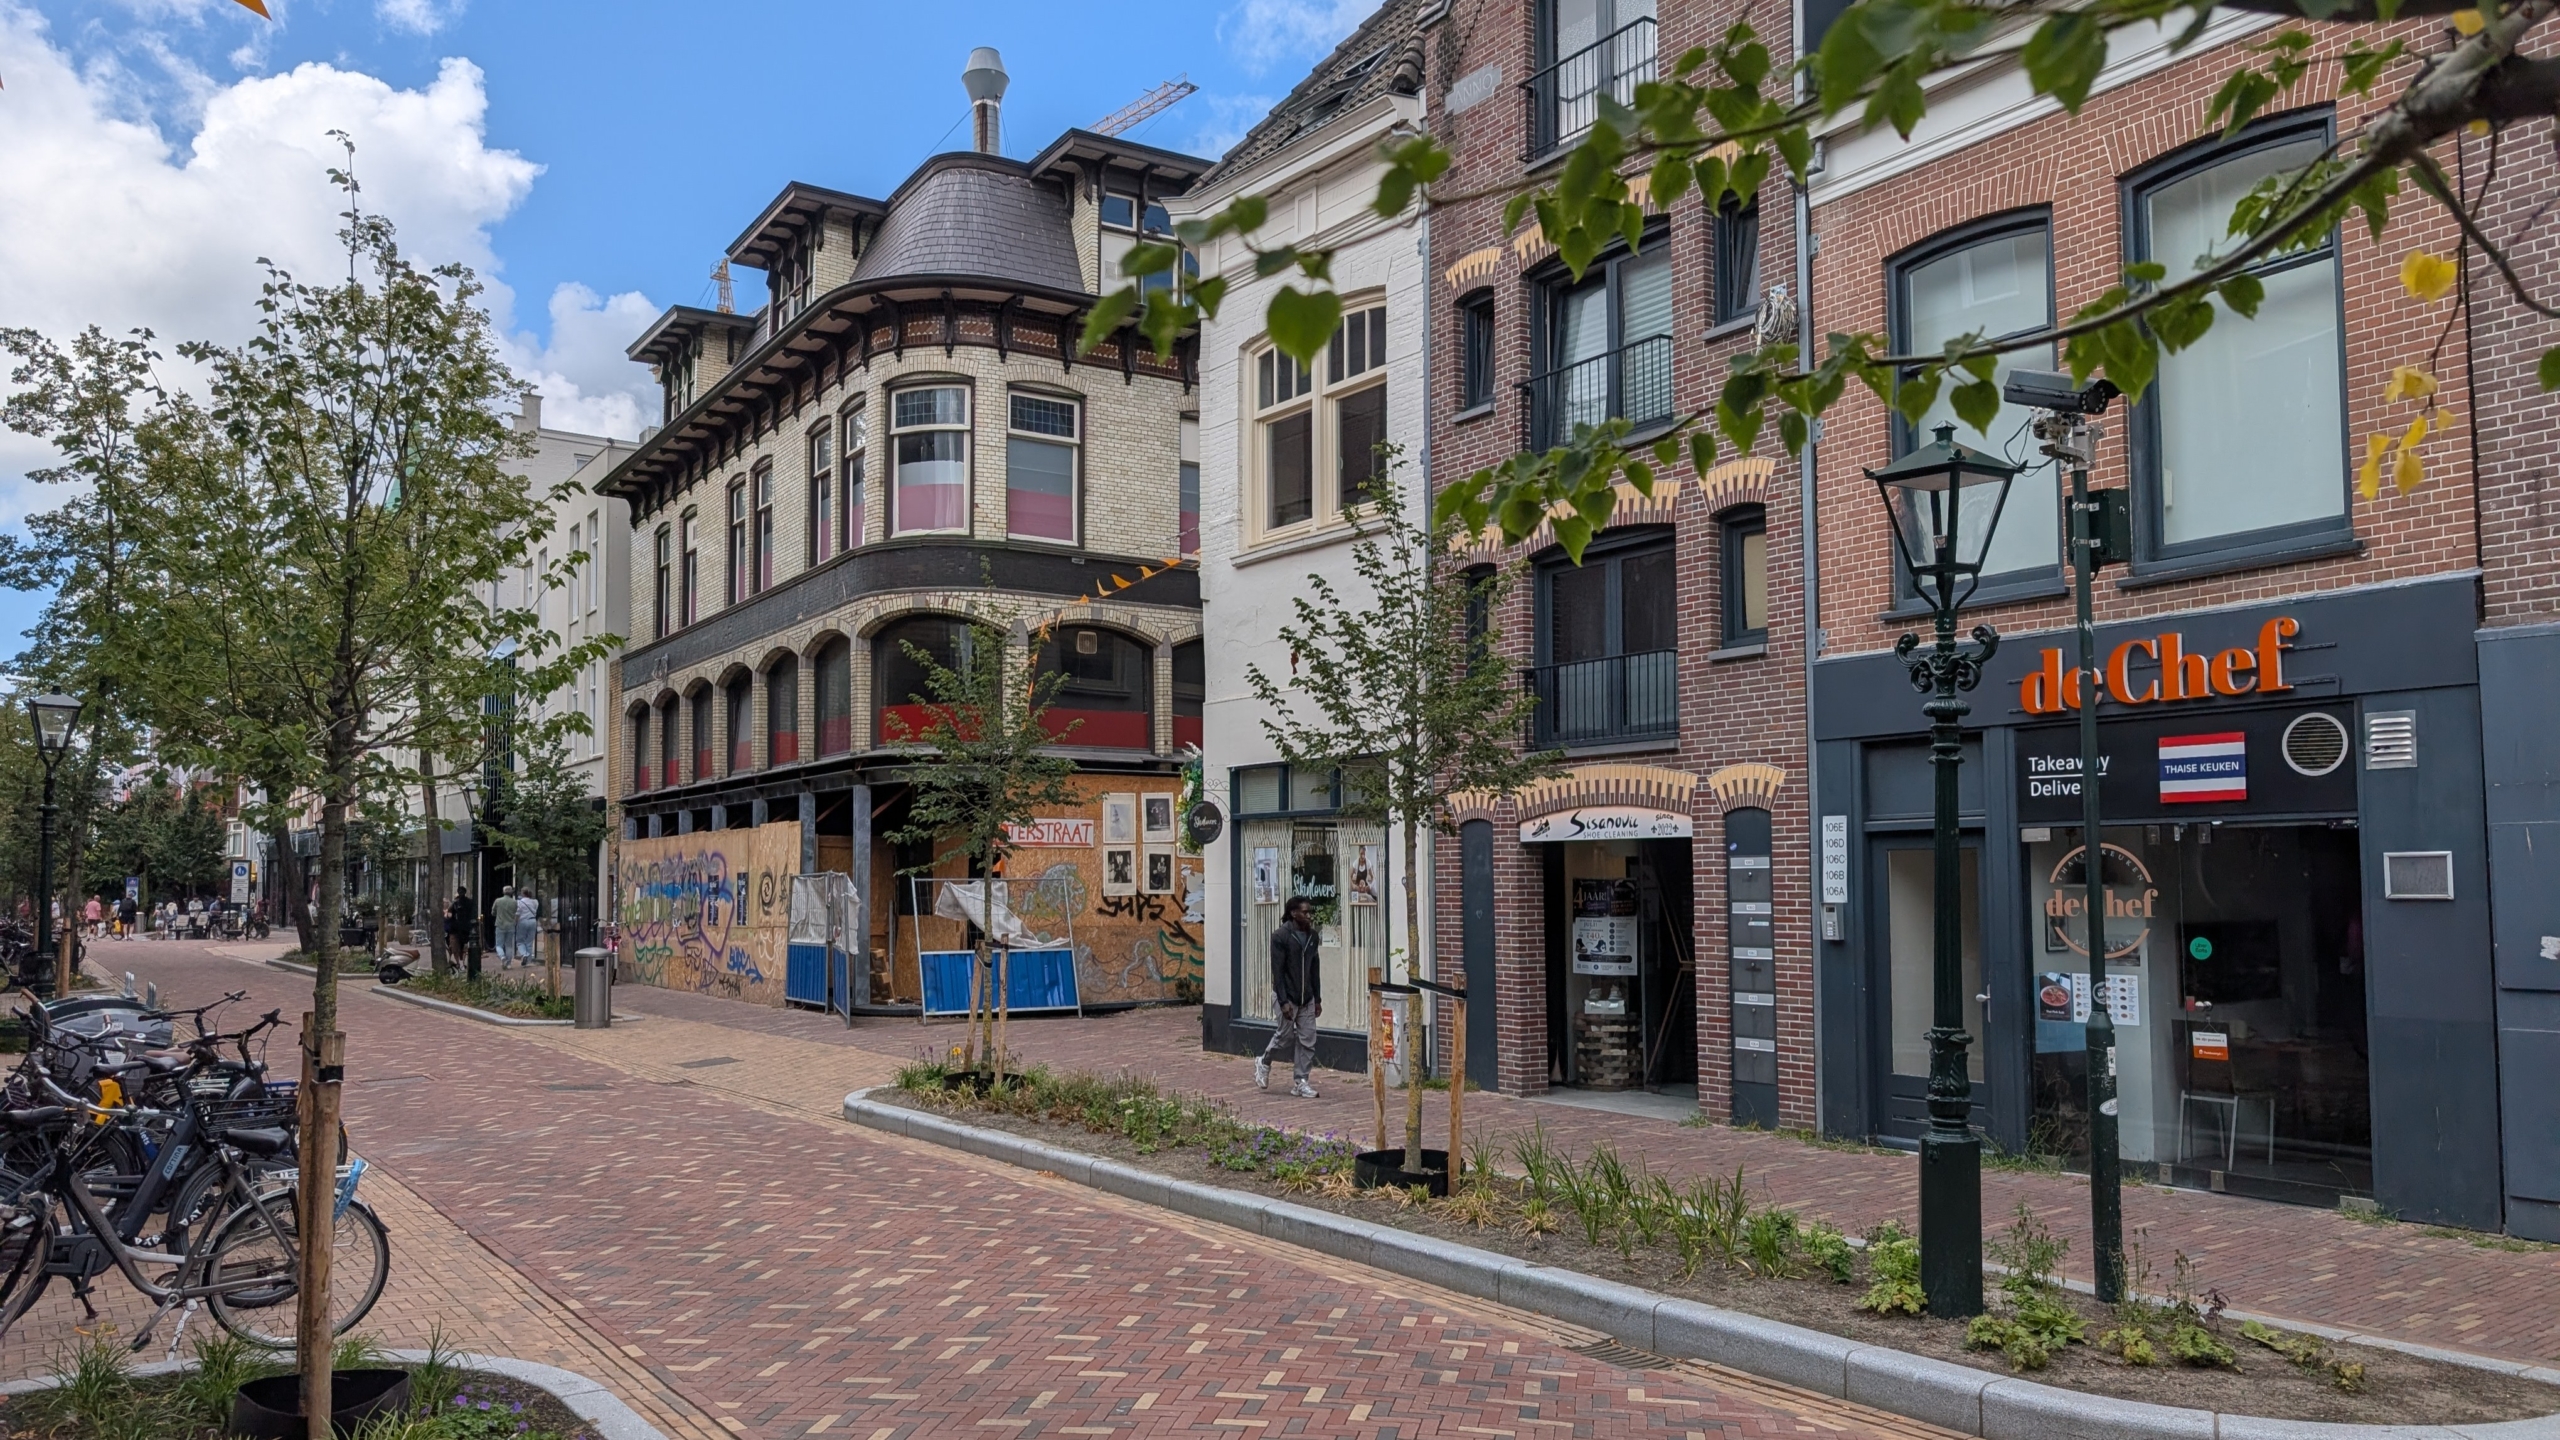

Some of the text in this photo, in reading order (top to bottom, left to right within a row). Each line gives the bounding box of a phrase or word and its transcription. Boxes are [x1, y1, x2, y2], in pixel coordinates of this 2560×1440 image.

[1454, 73, 1493, 106] ANNO
[2028, 755, 2110, 773] Takeawy
[2164, 761, 2240, 775] THAISE KEUKEN
[1006, 821, 1094, 843] TERSTRAAT
[1582, 829, 1639, 839] SHOE CLEANING
[1825, 822, 1844, 833] 106E
[1825, 838, 1845, 849] 106D
[1825, 854, 1846, 865] 106C
[2056, 848, 2145, 881] THAIS KEUKEN
[1825, 870, 1845, 880] 106B
[1293, 873, 1336, 899] Skinlovers
[1825, 886, 1845, 897] 106A
[2045, 888, 2159, 918] dehef
[164, 1147, 183, 1174] CORTINA
